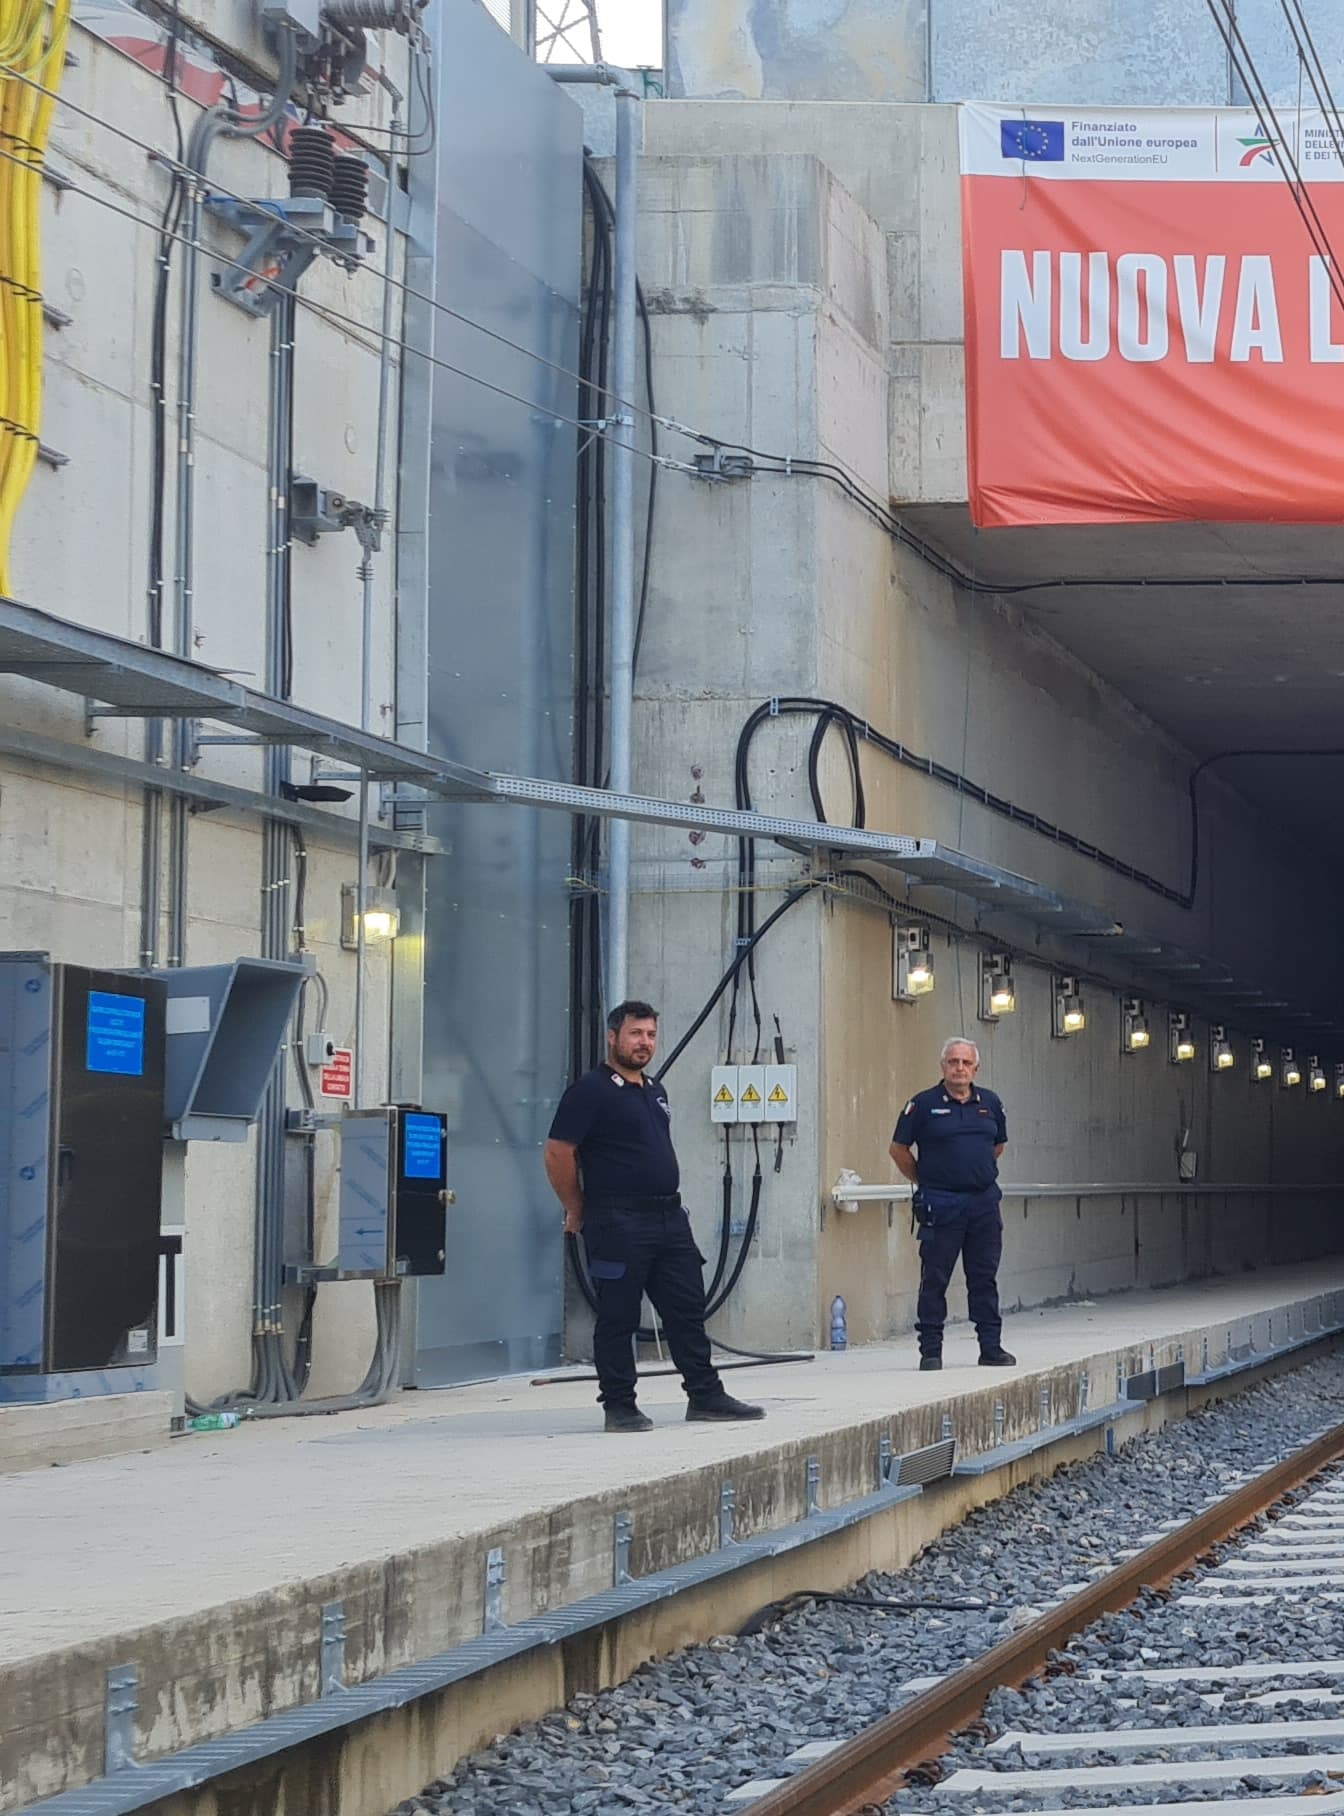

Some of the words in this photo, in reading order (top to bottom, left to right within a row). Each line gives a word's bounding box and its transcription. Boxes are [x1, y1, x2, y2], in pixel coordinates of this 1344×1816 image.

[1072, 121, 1137, 132] Finanziato
[1072, 136, 1144, 148] dall'Unione
[1146, 139, 1198, 149] europea
[1305, 140, 1335, 149] DELLE
[1072, 153, 1168, 164] NextGenerationEU
[1305, 151, 1311, 160] E
[1314, 151, 1330, 160] DEI
[1001, 249, 1284, 363] NUOVA
